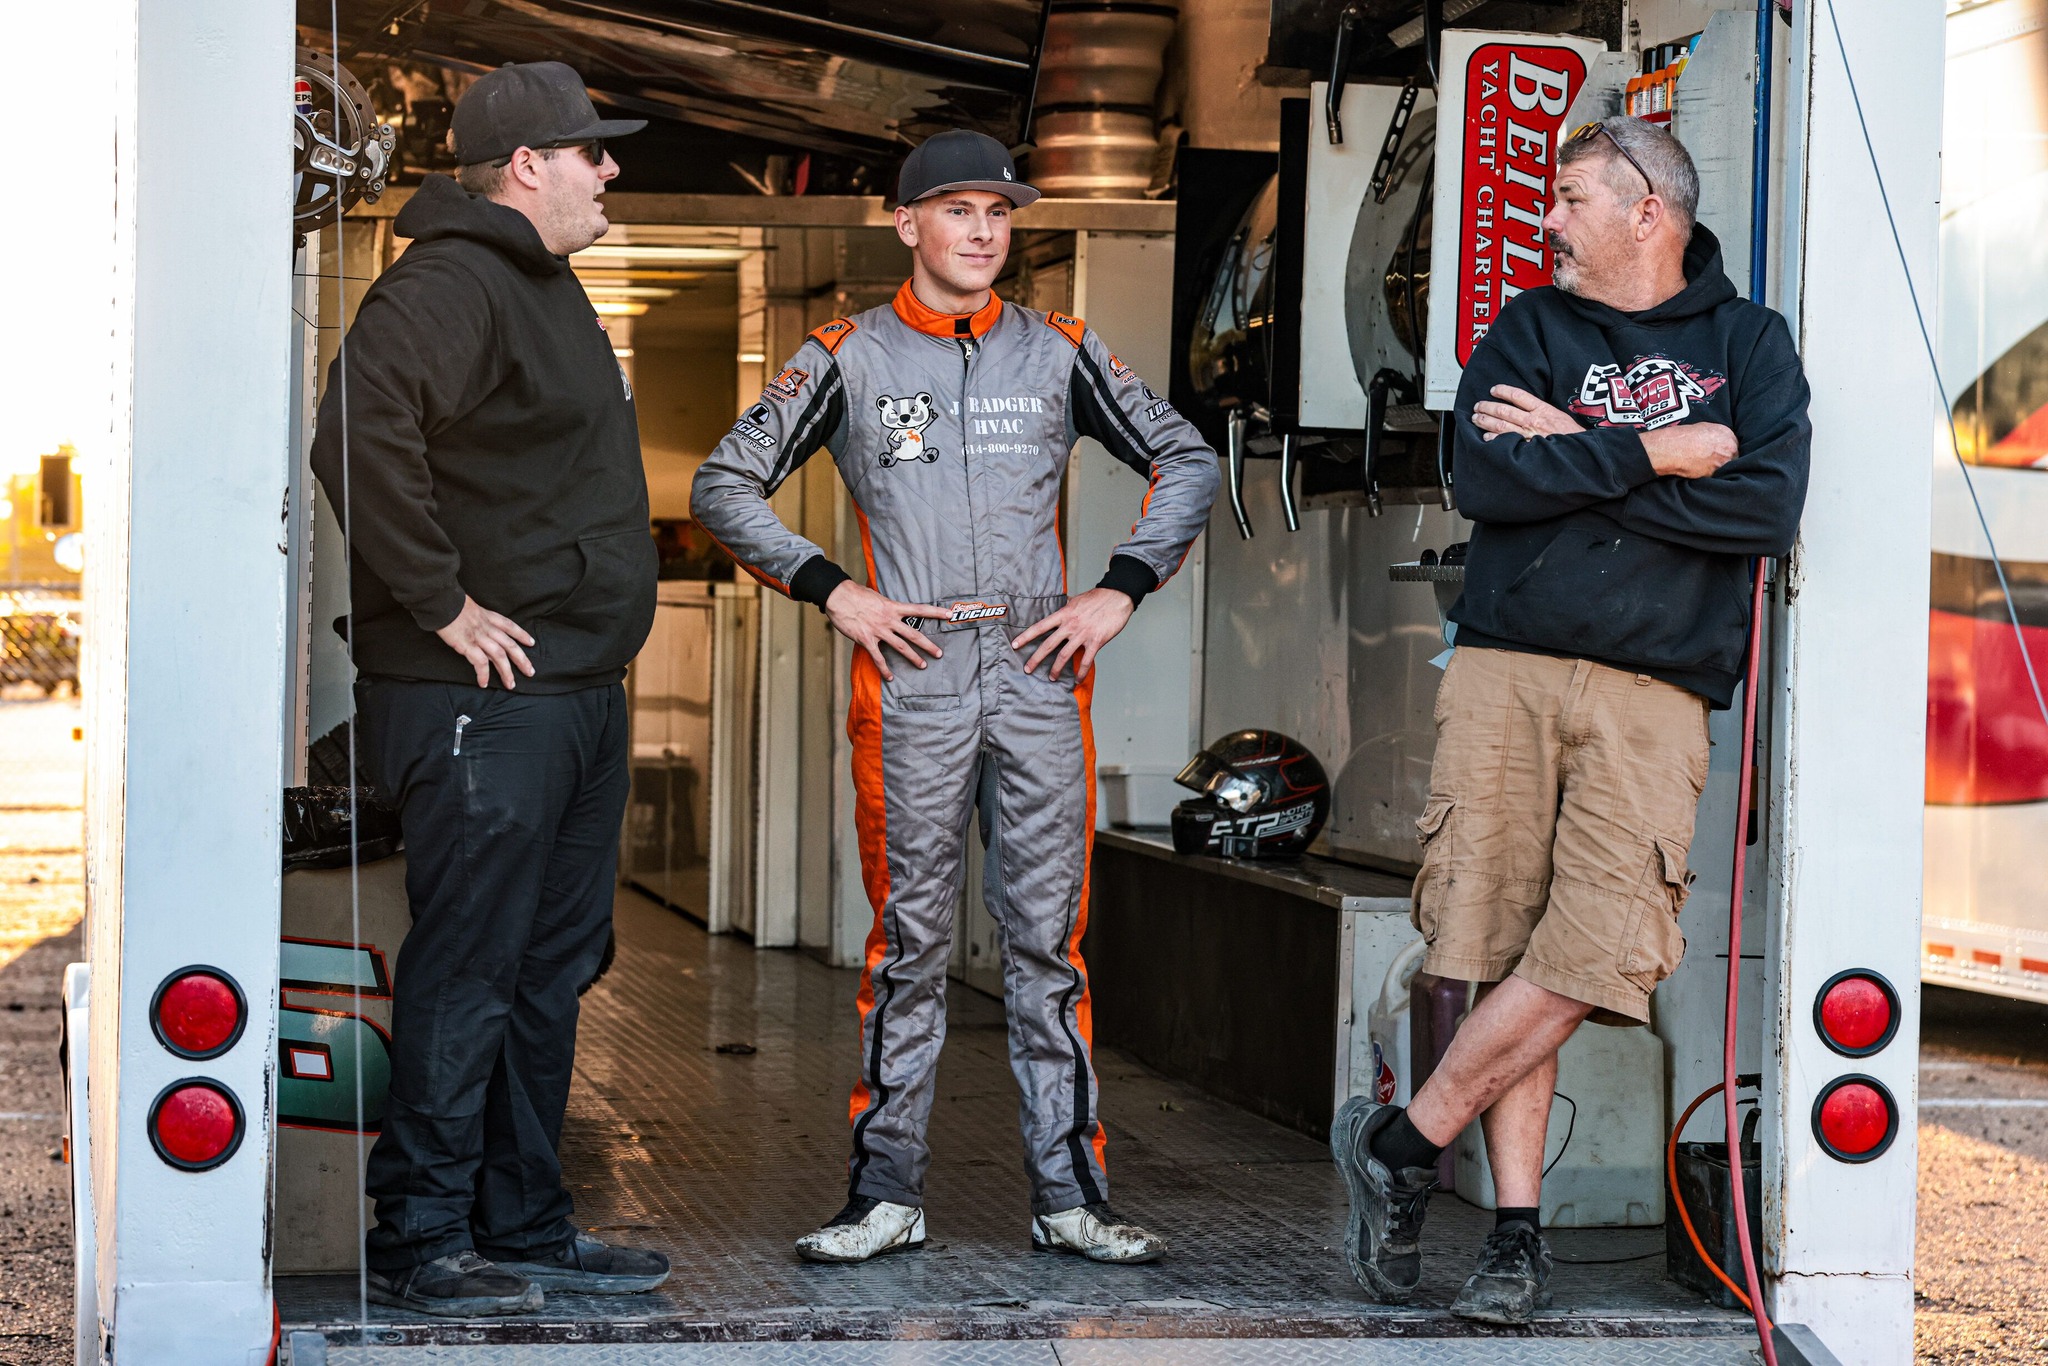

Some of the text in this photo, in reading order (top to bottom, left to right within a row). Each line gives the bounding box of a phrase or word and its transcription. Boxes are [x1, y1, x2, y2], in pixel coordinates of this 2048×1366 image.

[295, 93, 312, 102] EPS
[1472, 59, 1499, 353] YACHT CHARTER
[949, 396, 1043, 416] J BADGER
[974, 418, 1024, 435] HVAC
